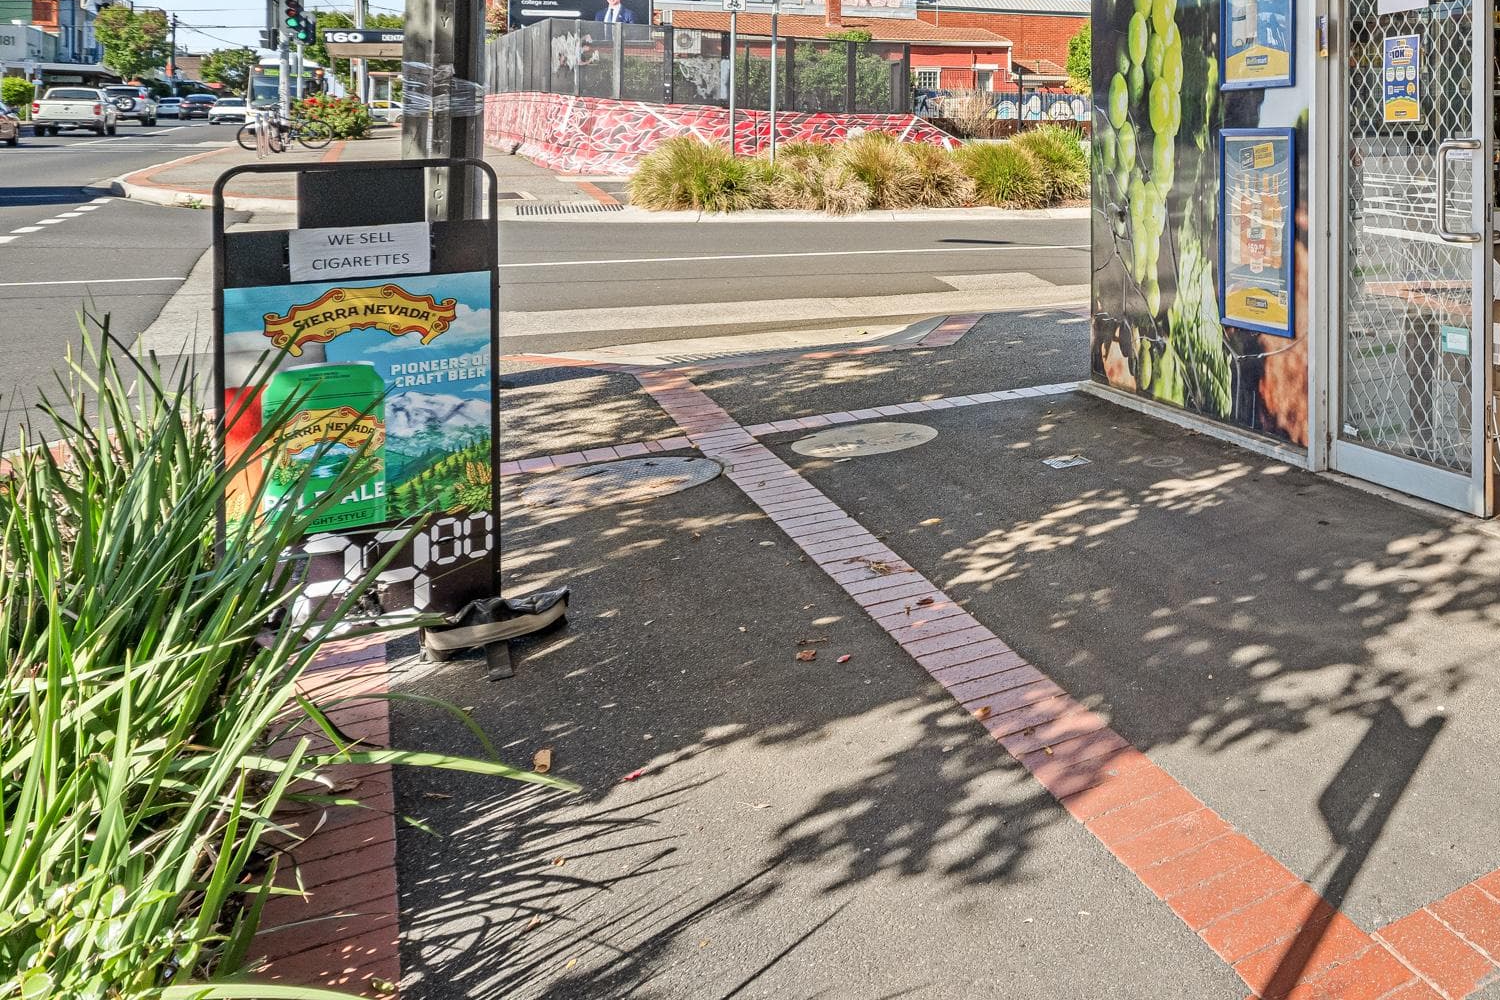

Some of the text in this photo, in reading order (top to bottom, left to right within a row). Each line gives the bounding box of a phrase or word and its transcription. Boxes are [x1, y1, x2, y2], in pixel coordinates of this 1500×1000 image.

[325, 32, 364, 43] 160
[328, 231, 395, 246] WE SELL
[312, 253, 410, 271] CIGARETTES
[292, 303, 430, 332] SIERRA NEVADA
[390, 355, 471, 376] PIONEERS
[395, 367, 486, 388] CRAFT BEER
